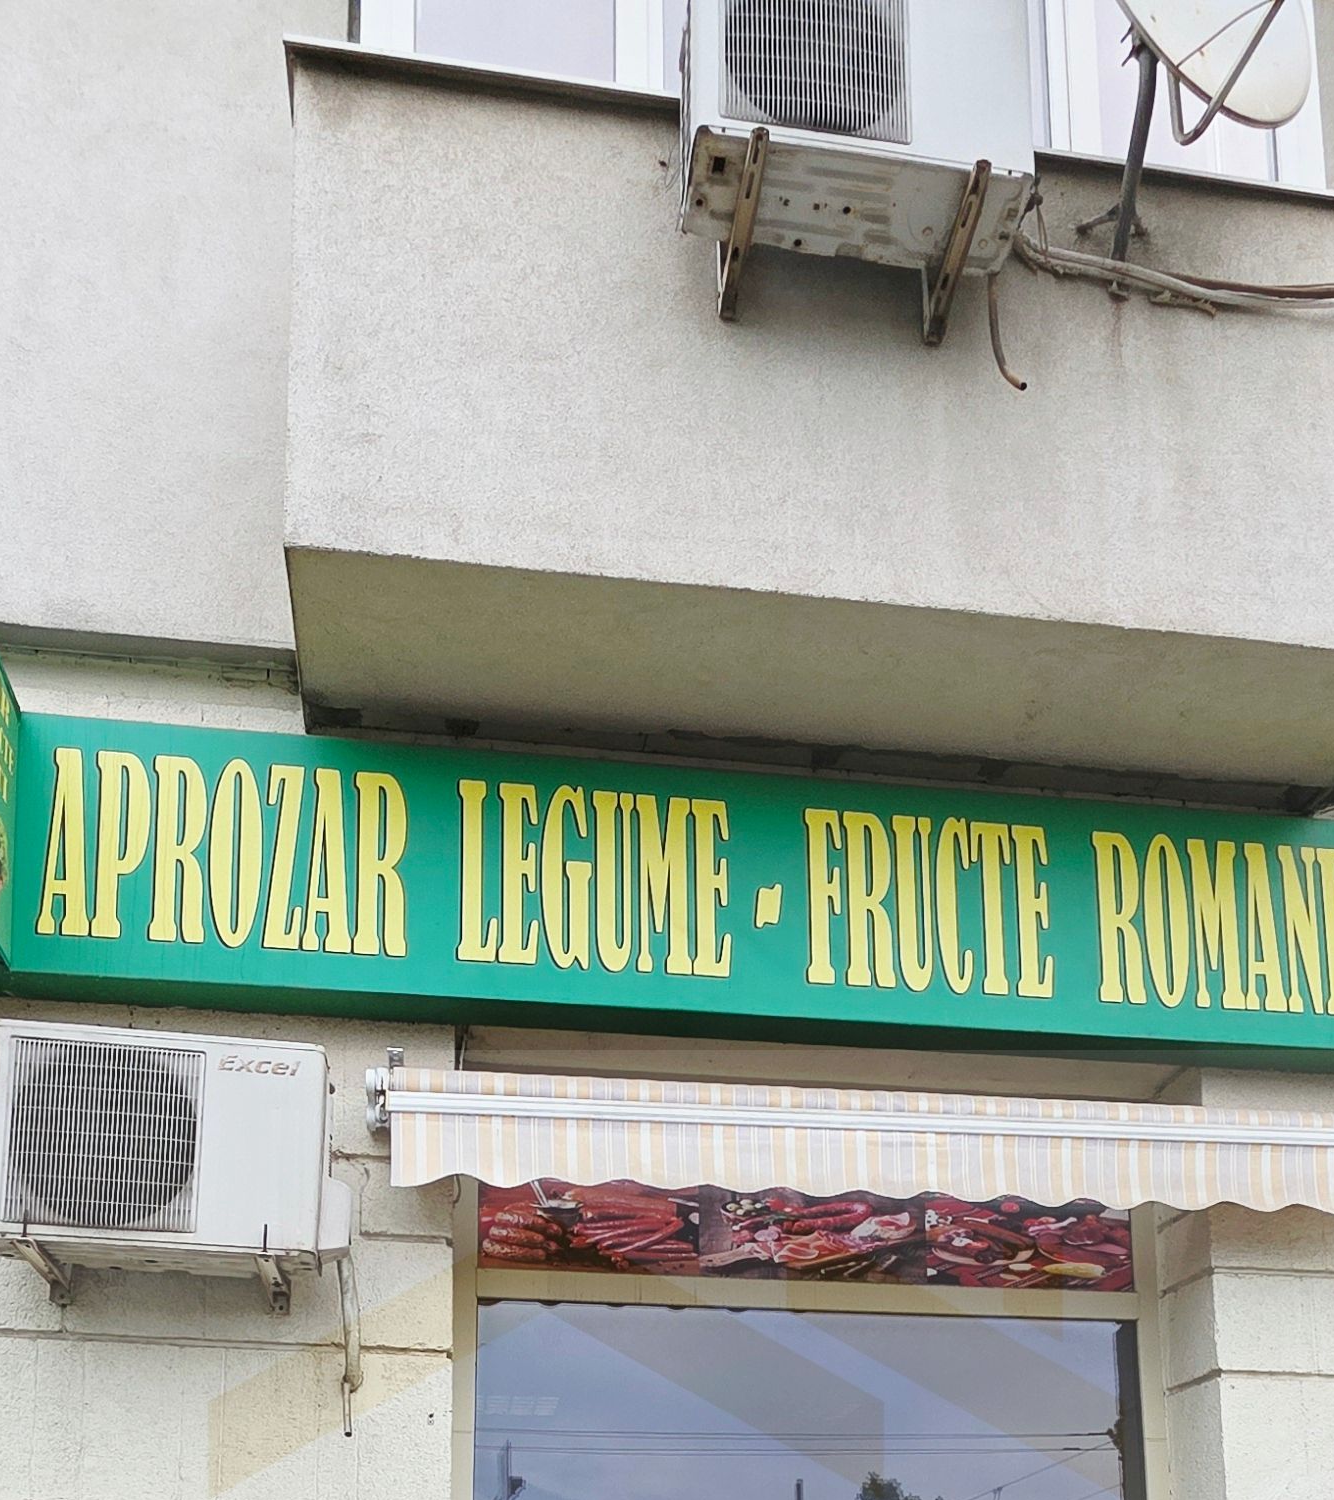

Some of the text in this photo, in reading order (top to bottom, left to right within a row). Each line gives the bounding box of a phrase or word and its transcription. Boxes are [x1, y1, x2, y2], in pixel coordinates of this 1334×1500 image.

[35, 747, 409, 958] APROZAR
[456, 778, 733, 978] LEGUME
[804, 807, 1055, 998] FRUCTE
[218, 1055, 301, 1076] Excel
